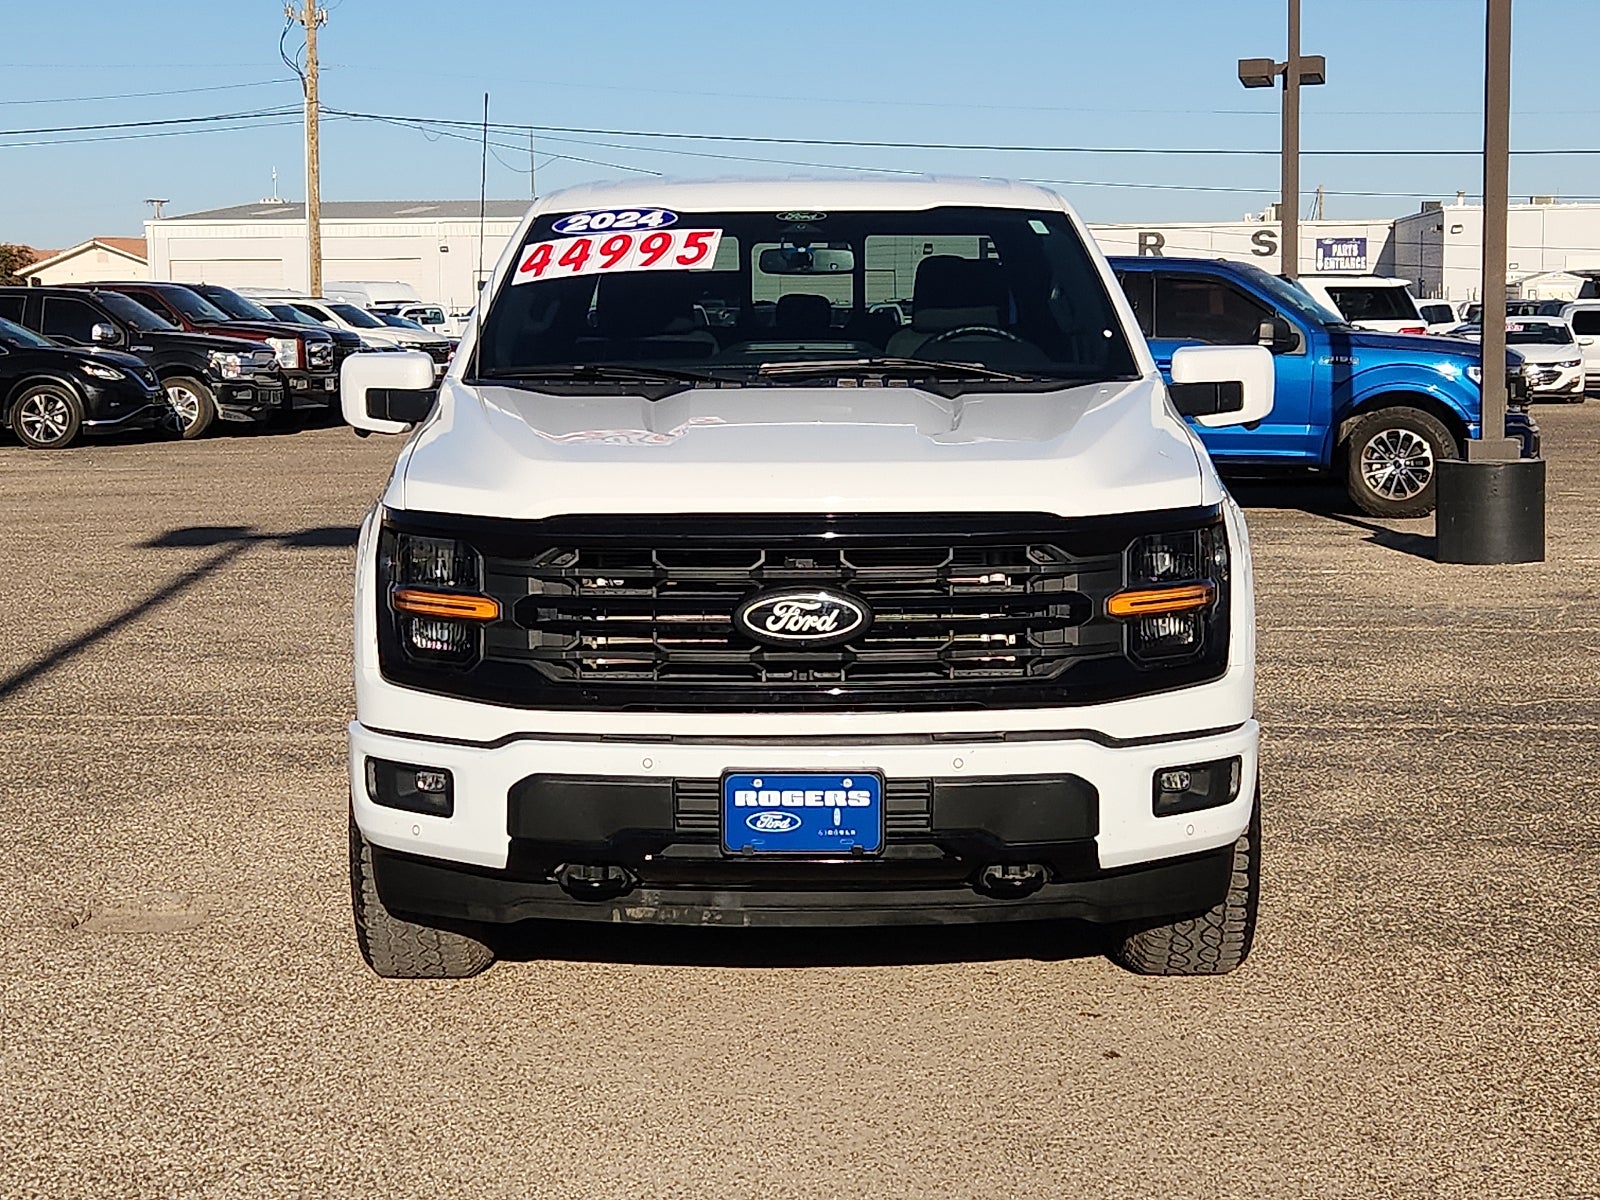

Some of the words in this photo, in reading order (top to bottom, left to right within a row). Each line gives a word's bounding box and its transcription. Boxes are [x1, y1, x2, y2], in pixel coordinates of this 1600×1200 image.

[563, 211, 663, 232] 2024
[1138, 231, 1166, 257] R
[1250, 229, 1278, 257] S
[1332, 244, 1359, 257] PARTS
[519, 231, 716, 278] 44995
[1323, 256, 1367, 270] ENTRANCE
[765, 601, 840, 632] Ford
[734, 790, 871, 807] ROGERS
[755, 814, 792, 830] Ford
